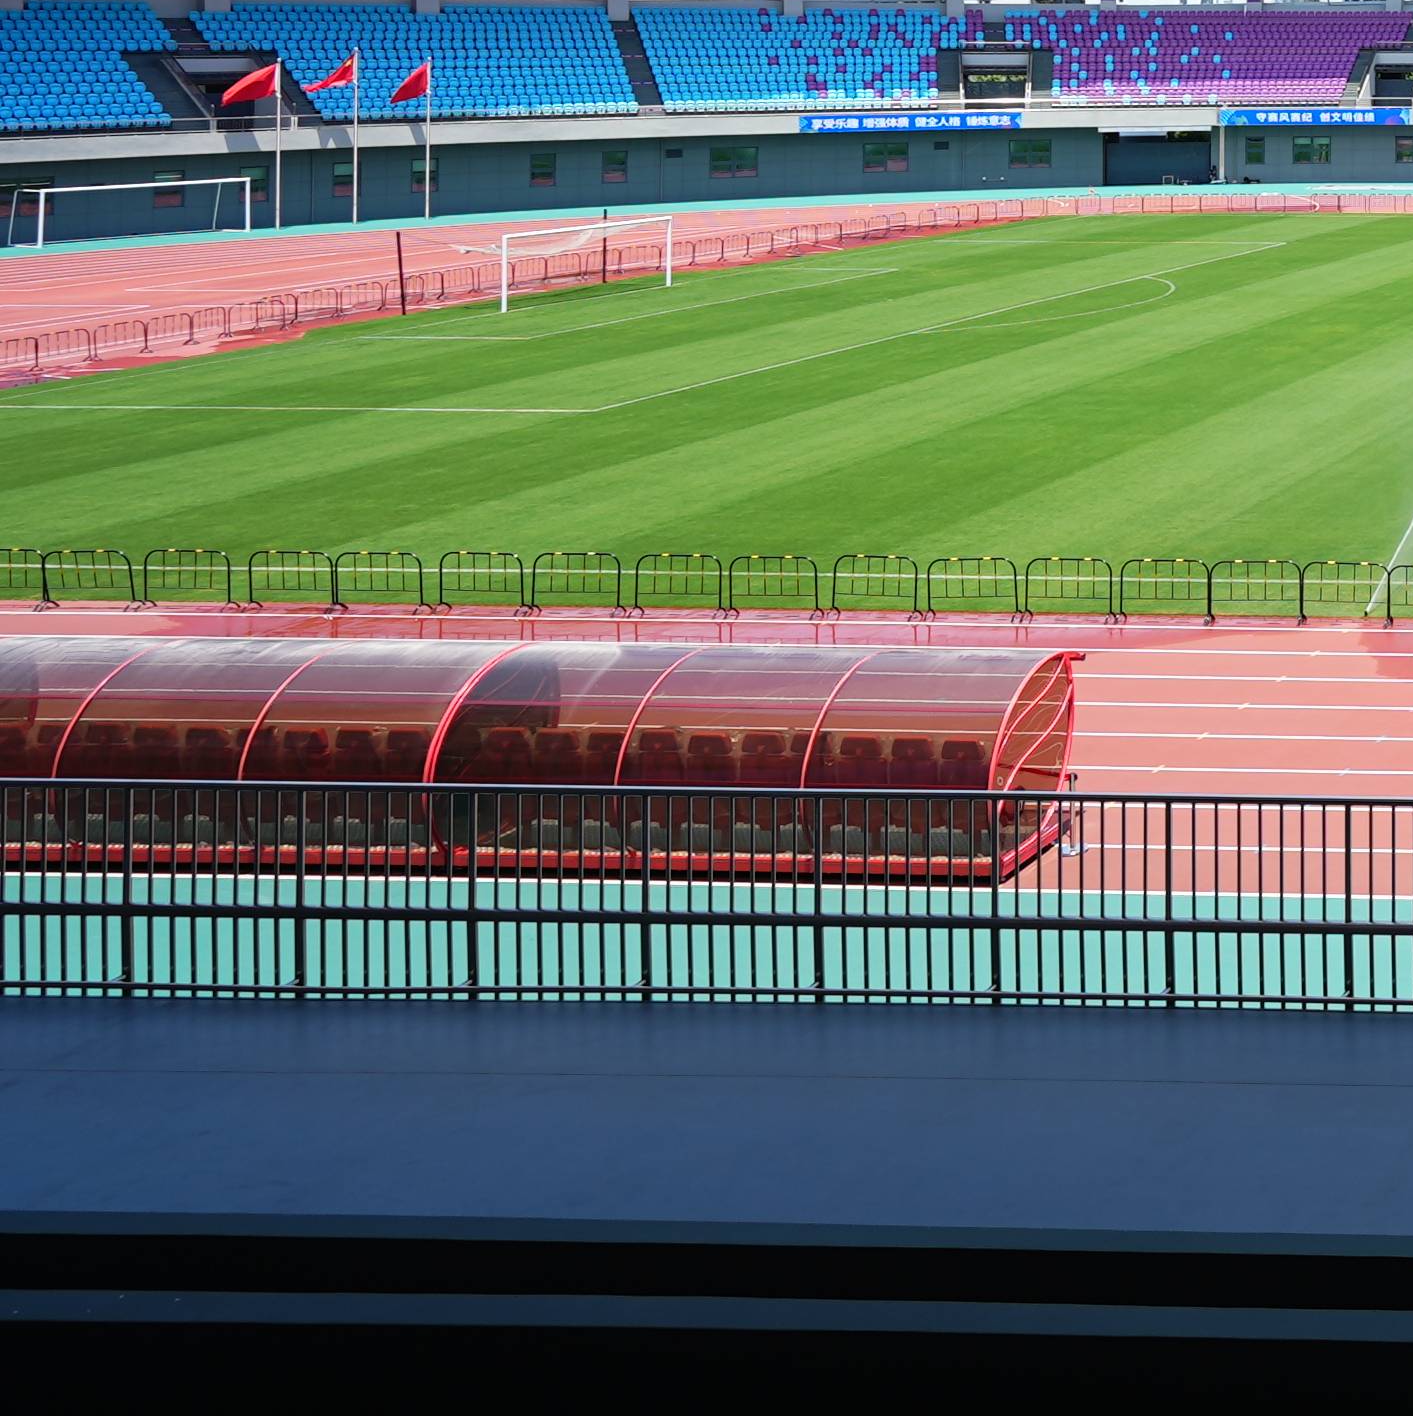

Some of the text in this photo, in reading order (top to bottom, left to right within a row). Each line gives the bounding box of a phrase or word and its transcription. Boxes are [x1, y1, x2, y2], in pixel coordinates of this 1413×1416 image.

[811, 115, 1011, 129] 享受乐趣 增强体质 健全人格 锤炼意志
[1255, 112, 1375, 123] 守赛风赛纪 创文明佳绩
